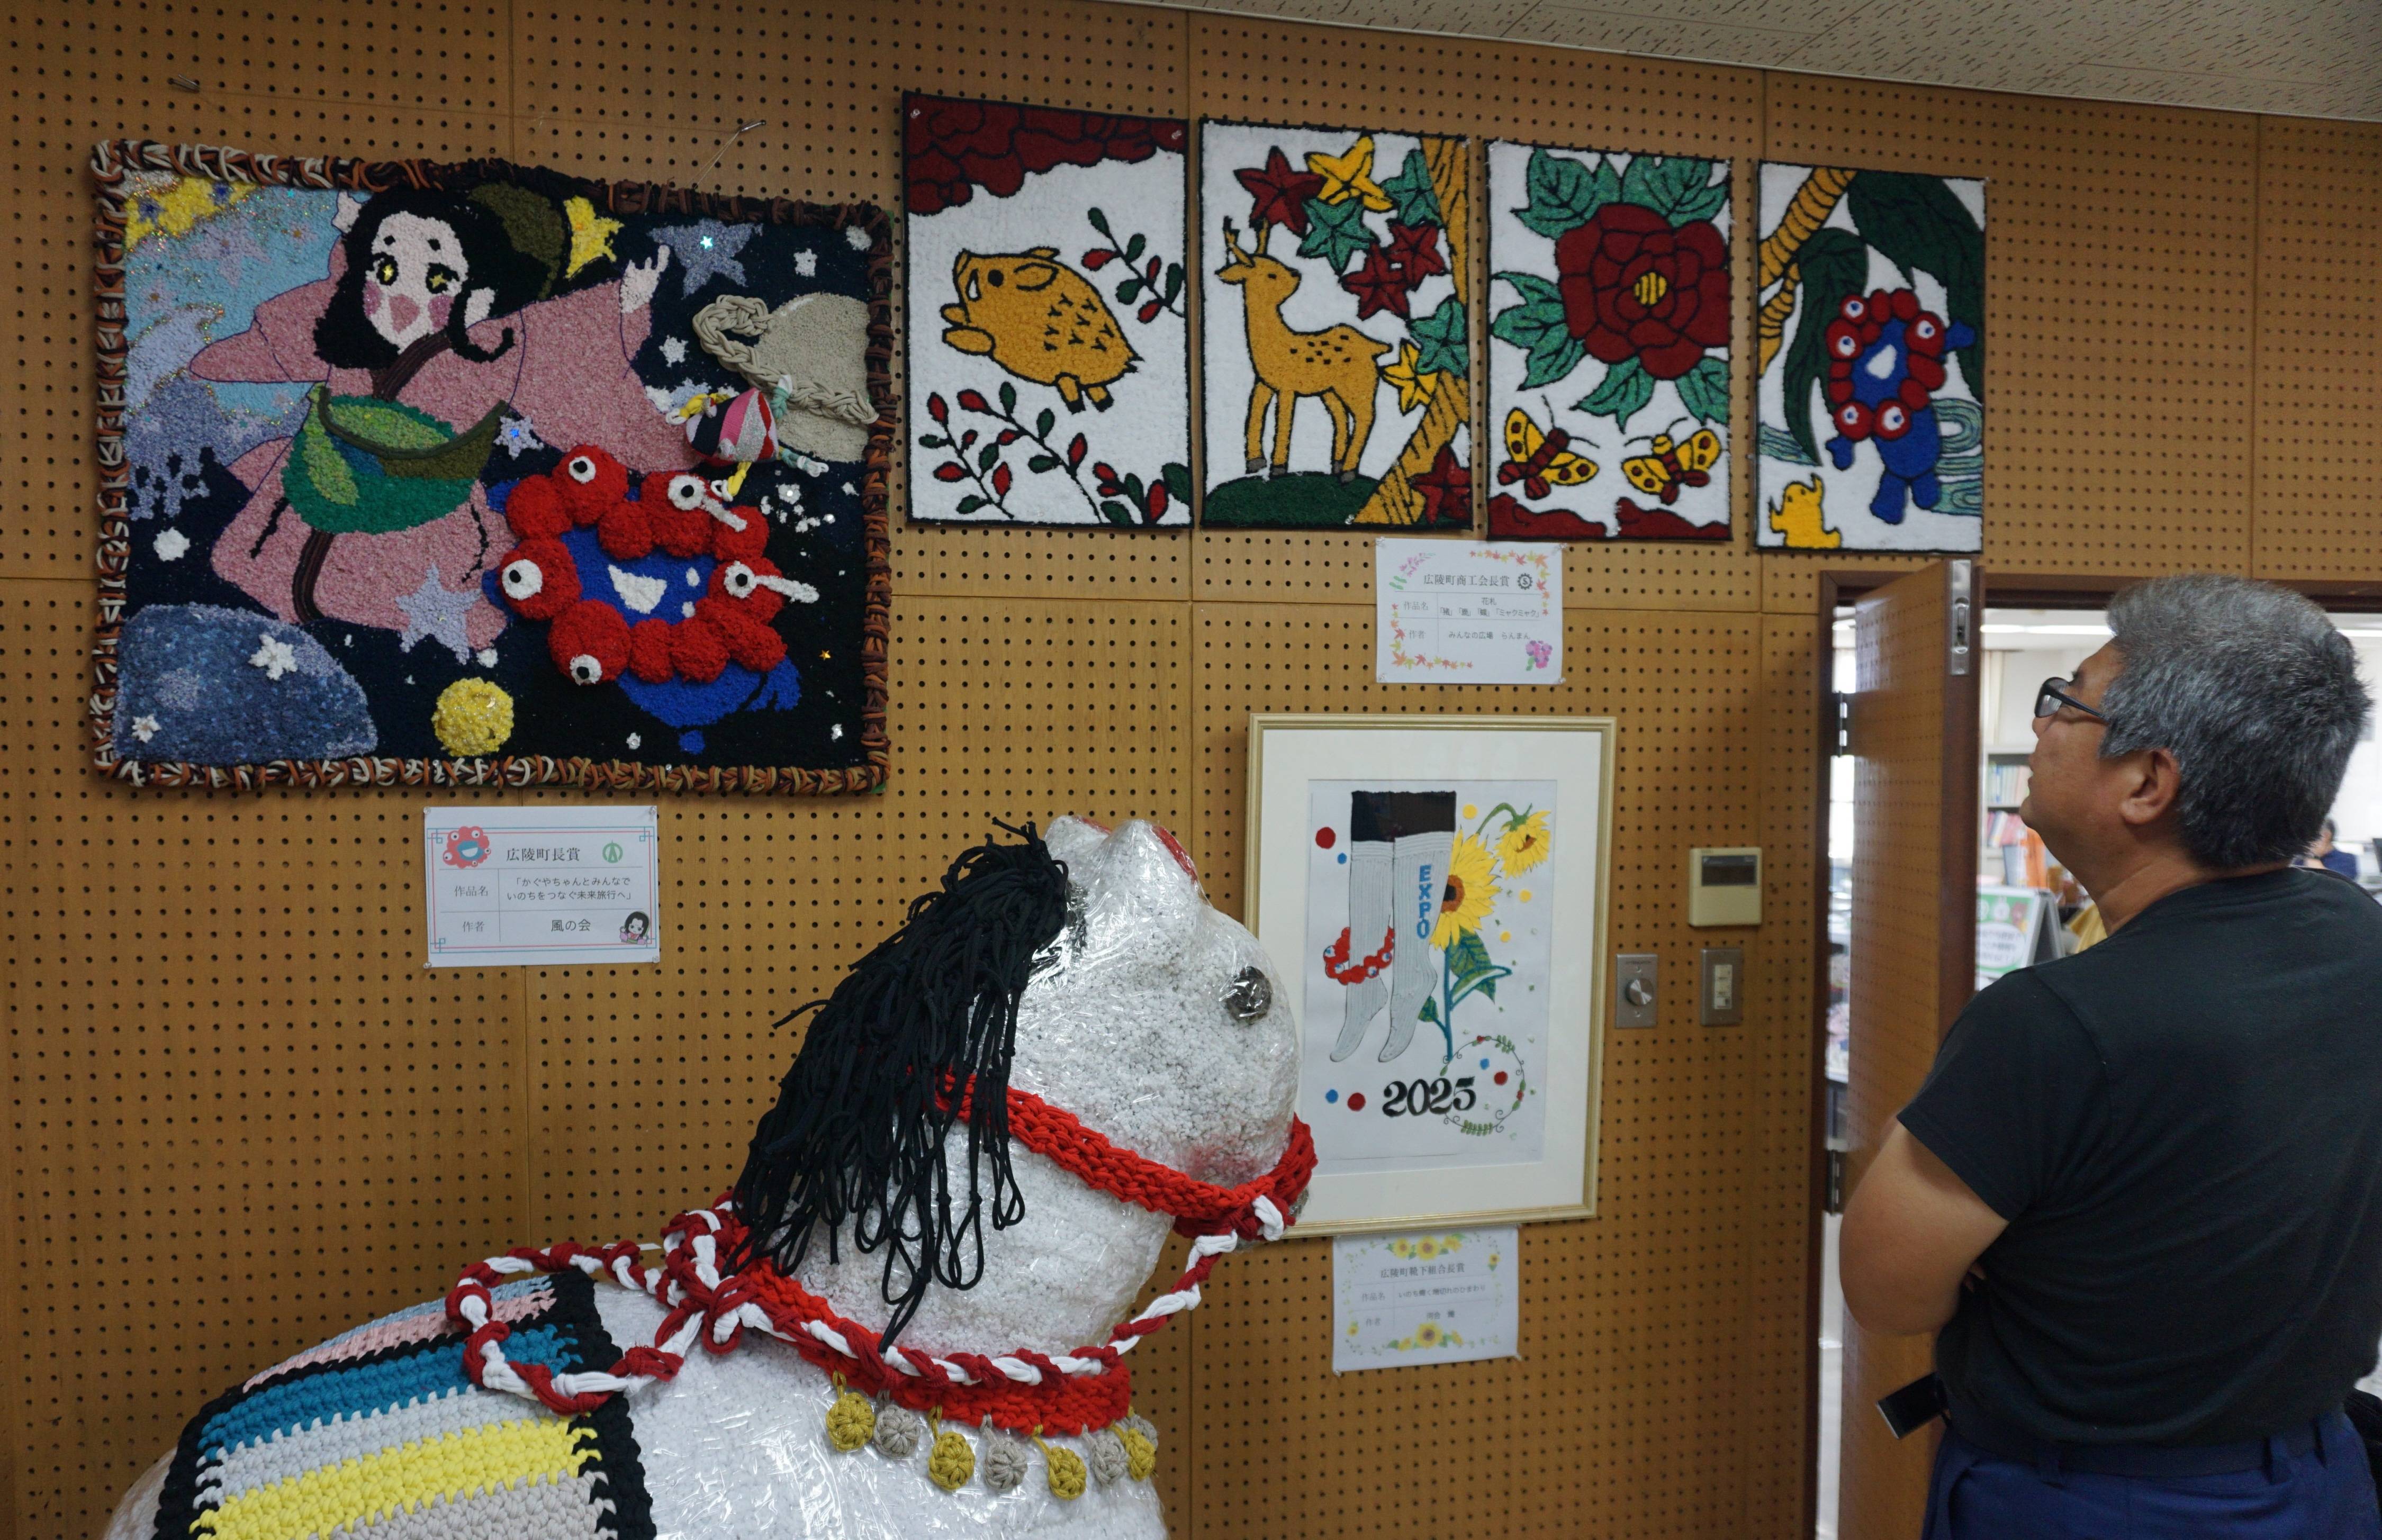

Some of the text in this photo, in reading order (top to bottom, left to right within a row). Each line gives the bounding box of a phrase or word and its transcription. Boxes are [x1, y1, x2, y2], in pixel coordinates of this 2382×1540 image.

[1423, 574, 1510, 587] 広陵町商工会長賞
[1404, 601, 1429, 611] 作品名
[1481, 597, 1497, 605] 花札
[1409, 630, 1426, 639] 作者
[1448, 631, 1494, 640] みんなの広場
[506, 848, 580, 862] 広陵町長賞
[516, 876, 631, 886] 「かぐやちゃんとみんなで
[454, 885, 489, 898] 作品名
[507, 890, 631, 900] いのちをつなぐ未来旅行へ」
[1417, 865, 1431, 939] EXPO
[462, 921, 485, 933] 作者
[551, 918, 591, 932] 風の会
[1382, 1076, 1476, 1118] 2025
